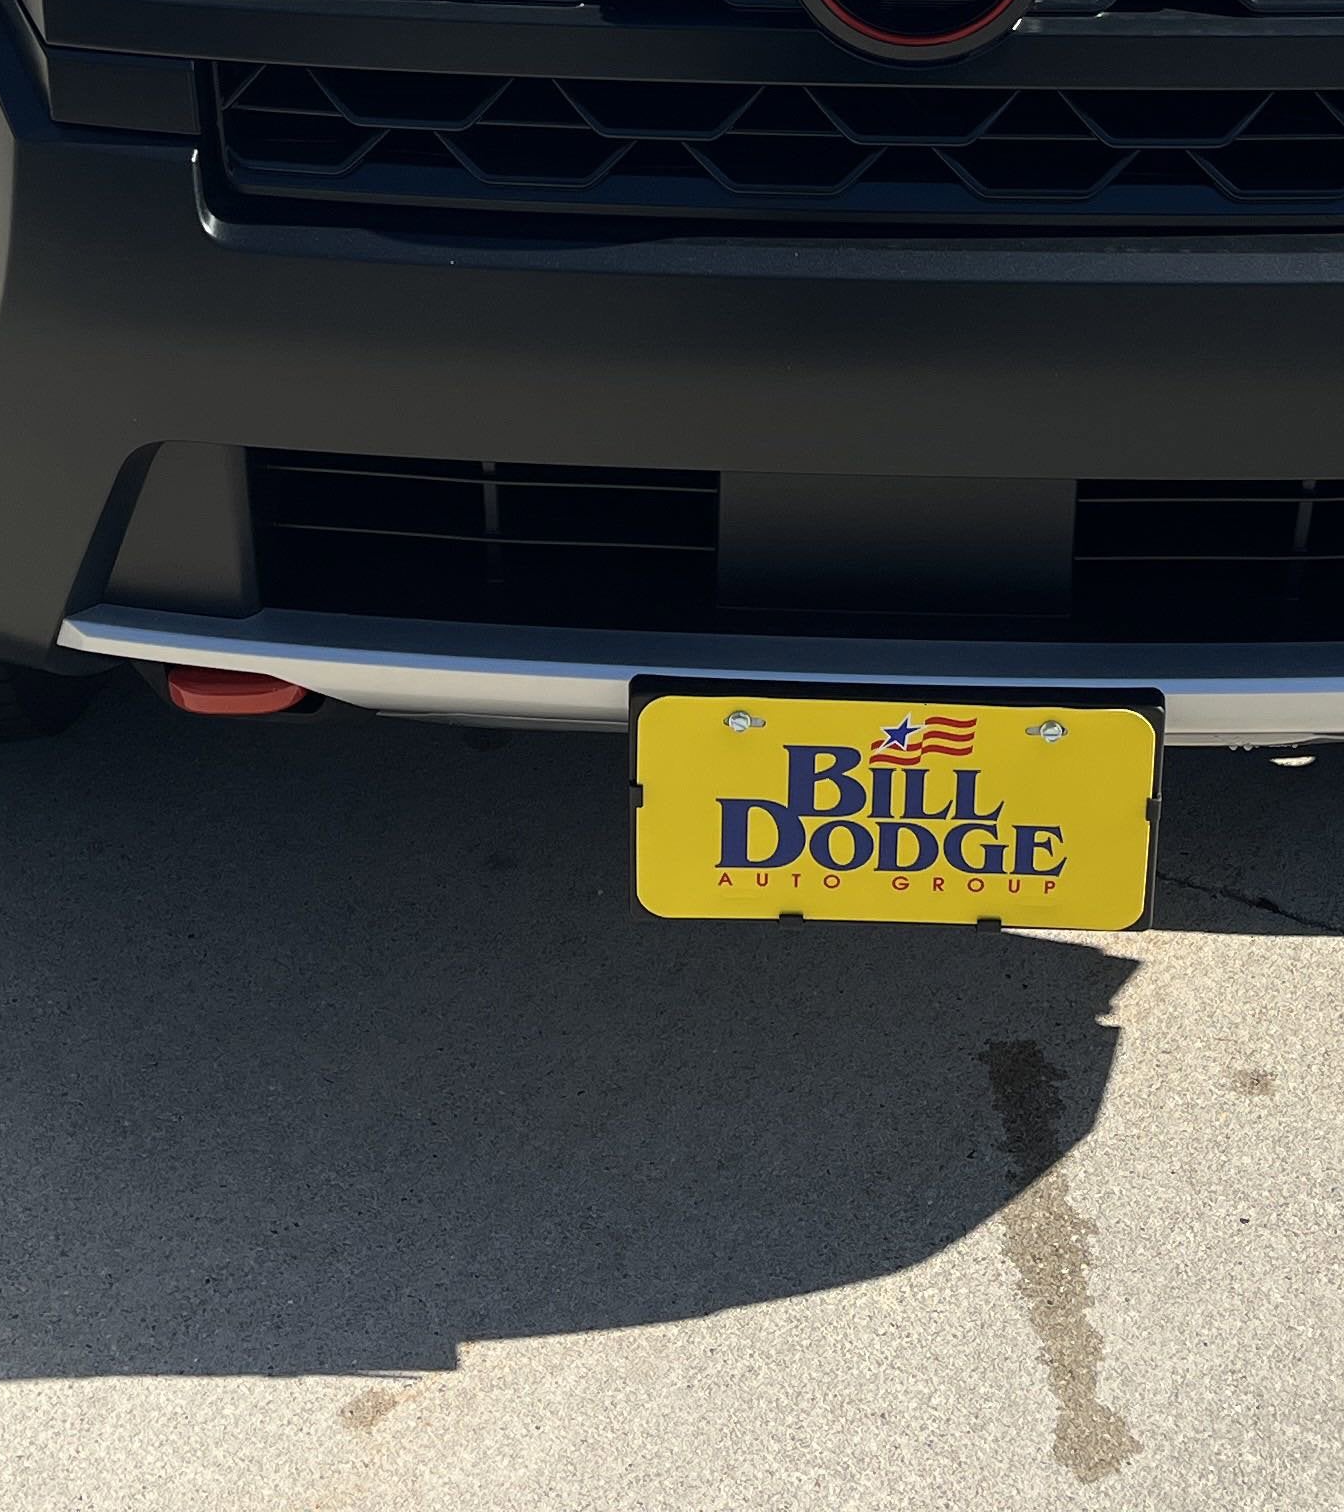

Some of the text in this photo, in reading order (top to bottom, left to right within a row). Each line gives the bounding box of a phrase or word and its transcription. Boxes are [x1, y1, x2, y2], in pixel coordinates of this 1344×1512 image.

[782, 744, 1005, 821] BILL
[714, 798, 1068, 878] DODGE
[717, 872, 1057, 894] AUTO GROUP
